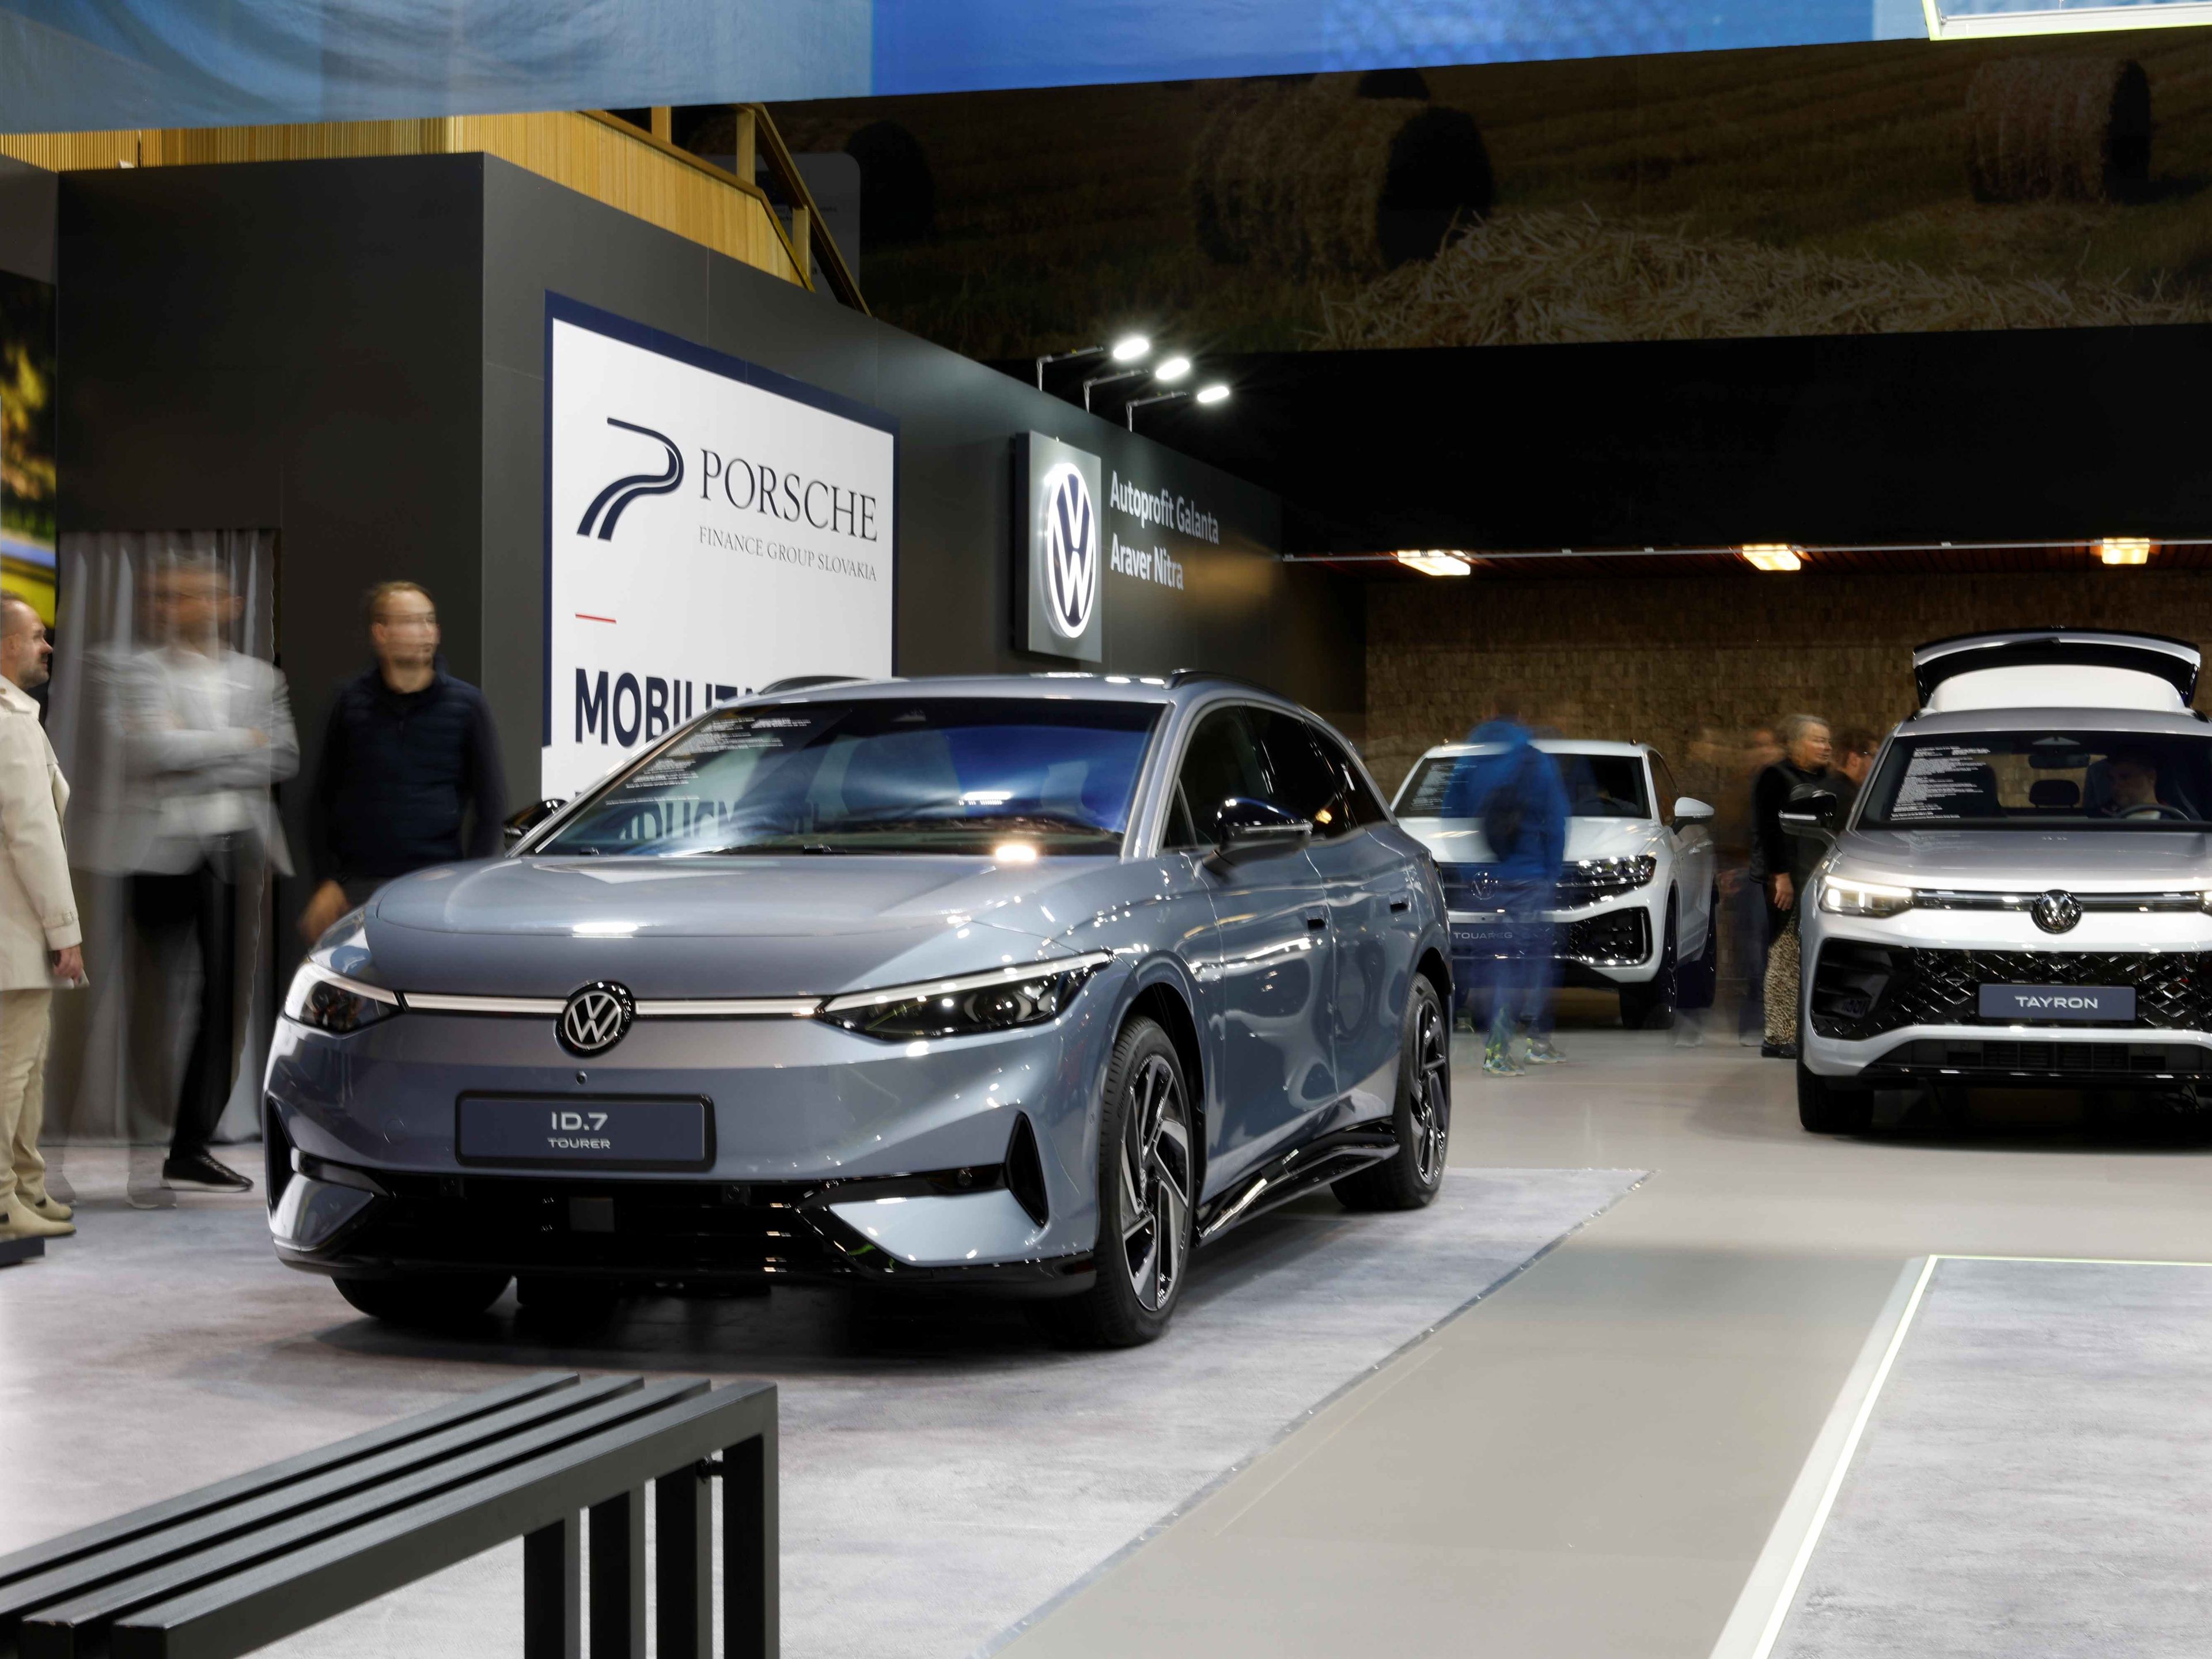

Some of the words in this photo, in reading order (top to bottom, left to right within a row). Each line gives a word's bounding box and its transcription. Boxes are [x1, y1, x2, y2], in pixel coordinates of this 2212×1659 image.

[699, 448, 878, 542] PORSCHE
[1110, 470, 1175, 529] Autoprofit
[1176, 495, 1219, 545] Galanta
[699, 525, 764, 557] FINANCE
[767, 542, 815, 569] GROUP
[817, 554, 877, 582] SLOVAKIA
[1110, 532, 1152, 581] Araver
[1154, 546, 1184, 590] Nitra
[576, 668, 753, 747] MOBIL
[2014, 995, 2099, 1009] TAYRON
[547, 1137, 611, 1149] TOURER
[551, 1112, 608, 1131] ID.7
